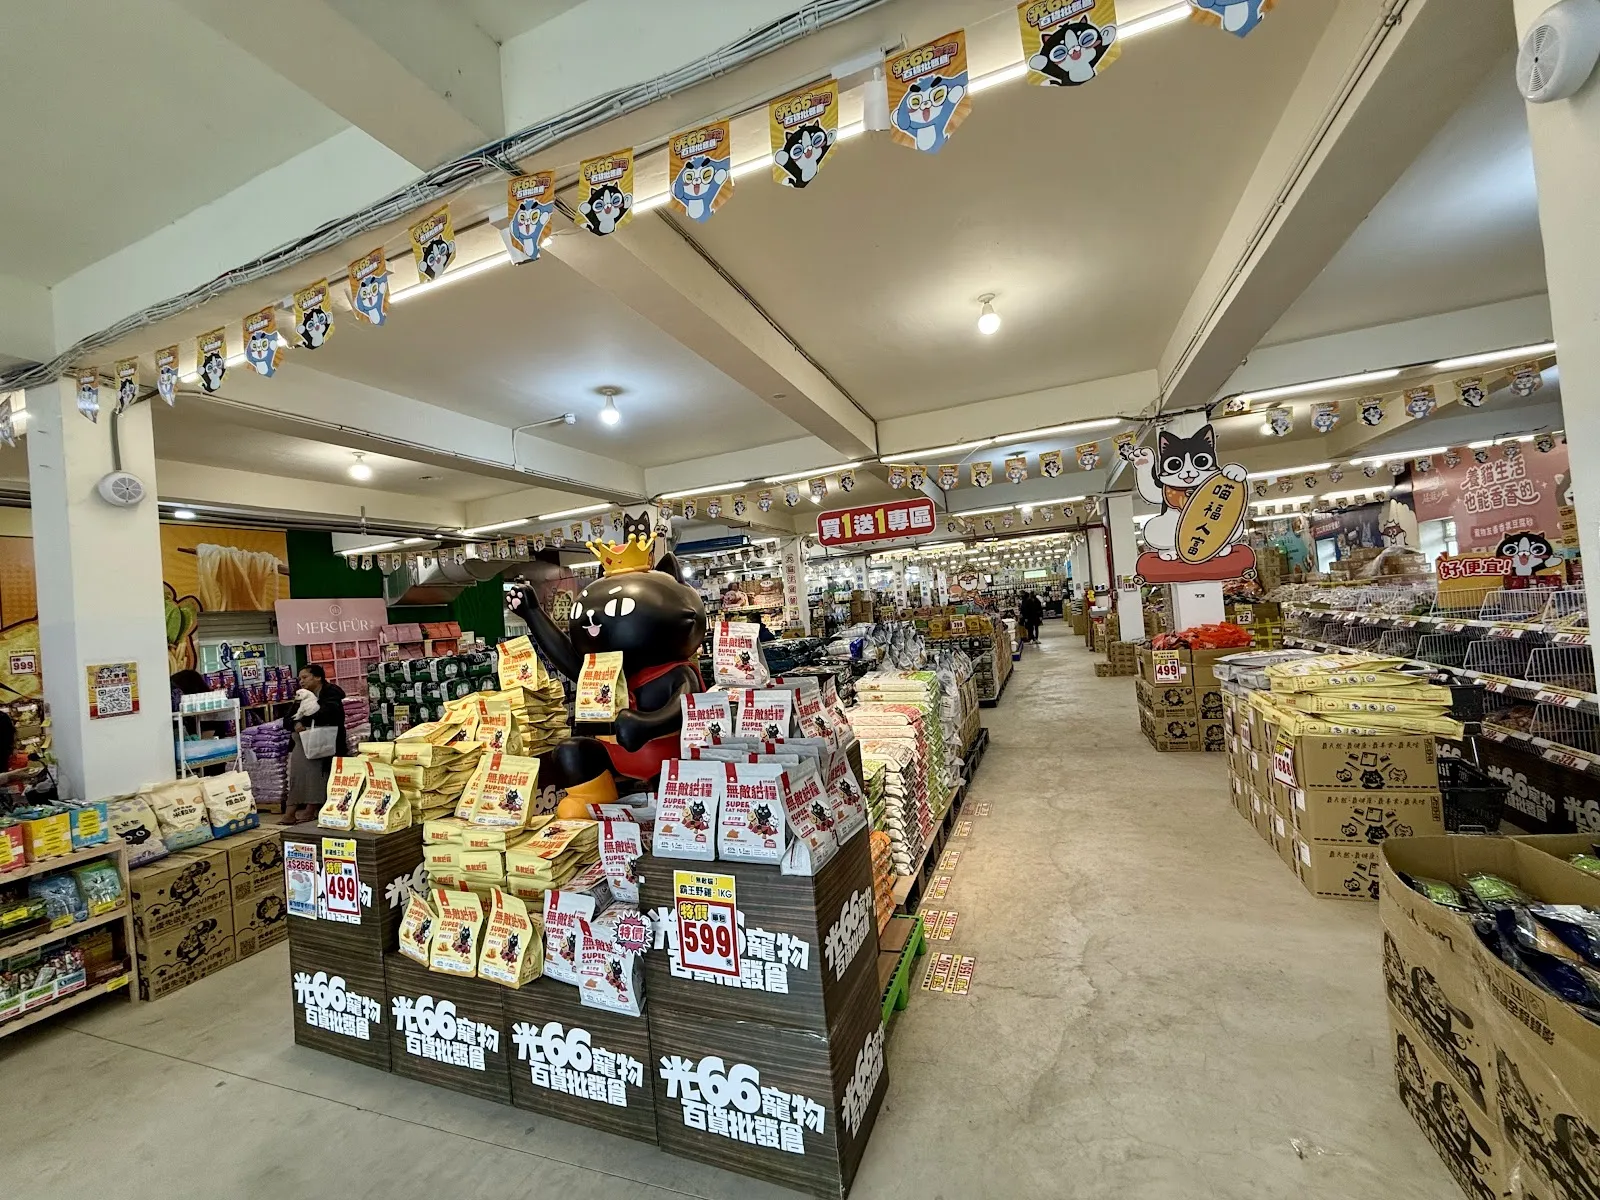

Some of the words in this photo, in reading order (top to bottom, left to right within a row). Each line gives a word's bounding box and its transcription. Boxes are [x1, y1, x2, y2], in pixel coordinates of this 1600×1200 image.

[893, 42, 958, 76] 光66寵物
[1461, 456, 1526, 490] 養貓生活
[1464, 481, 1540, 514] 也能香香的
[821, 505, 932, 540] 買1送1專區
[1440, 558, 1513, 580] 好便宜!
[297, 618, 368, 634] MERCIFÜR
[13, 662, 33, 671] 999
[1158, 665, 1177, 675] 499
[687, 704, 725, 721] 無敵貓糧
[743, 704, 784, 721] 無敵貓糧
[487, 772, 528, 786] 無敵貓糧
[666, 778, 712, 798] 無敵貓糧
[726, 781, 777, 800] 無敵貓糧
[604, 838, 638, 855] 無敵貓糧
[329, 876, 355, 901] 499
[443, 904, 478, 923] 無敵貓糧
[493, 910, 527, 930] 無敵貓糧
[546, 910, 584, 928] 無敵貓
[680, 902, 708, 920] 特價
[490, 926, 508, 934] SUPER
[619, 925, 644, 942] 特價
[684, 921, 731, 957] 599
[824, 886, 872, 971] 光66寵物
[582, 936, 613, 951] 無敵貓
[294, 971, 381, 1024] 光66寵物
[304, 1003, 370, 1040] 百貨批發倉
[392, 995, 499, 1053] 光66寵物
[405, 1031, 486, 1071] 百貨批發倉
[512, 1022, 643, 1087] 光66寵物
[529, 1059, 628, 1108] 百貨批發倉
[659, 1055, 826, 1134] 光66寵物
[681, 1098, 805, 1155] 百貨批發倉
